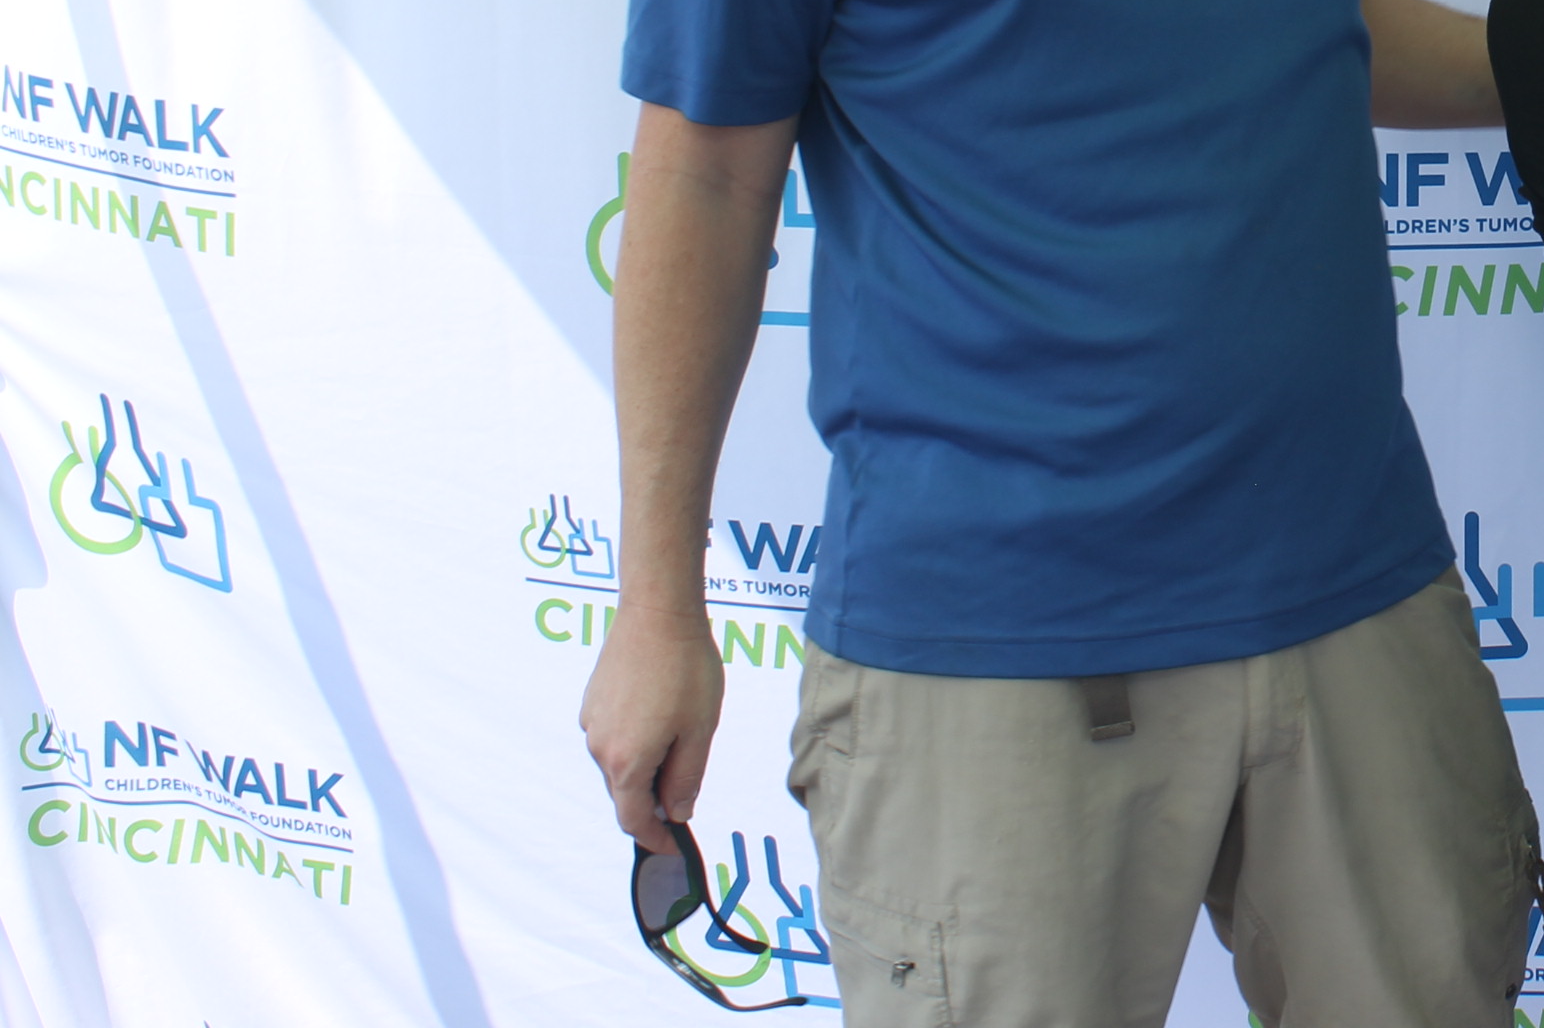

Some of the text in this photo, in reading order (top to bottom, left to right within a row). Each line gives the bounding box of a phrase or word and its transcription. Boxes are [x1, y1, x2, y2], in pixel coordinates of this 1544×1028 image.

[2, 64, 231, 159] NF WALK
[1, 124, 236, 183] CHILDREN'S TUMOR FOUNDATION
[1384, 219, 1470, 235] LDREN'S
[103, 720, 349, 819] NF WALK
[103, 777, 203, 799] CHILDREN'S
[249, 810, 353, 841] FOUNDATION
[27, 799, 353, 906] CINCINNATI
